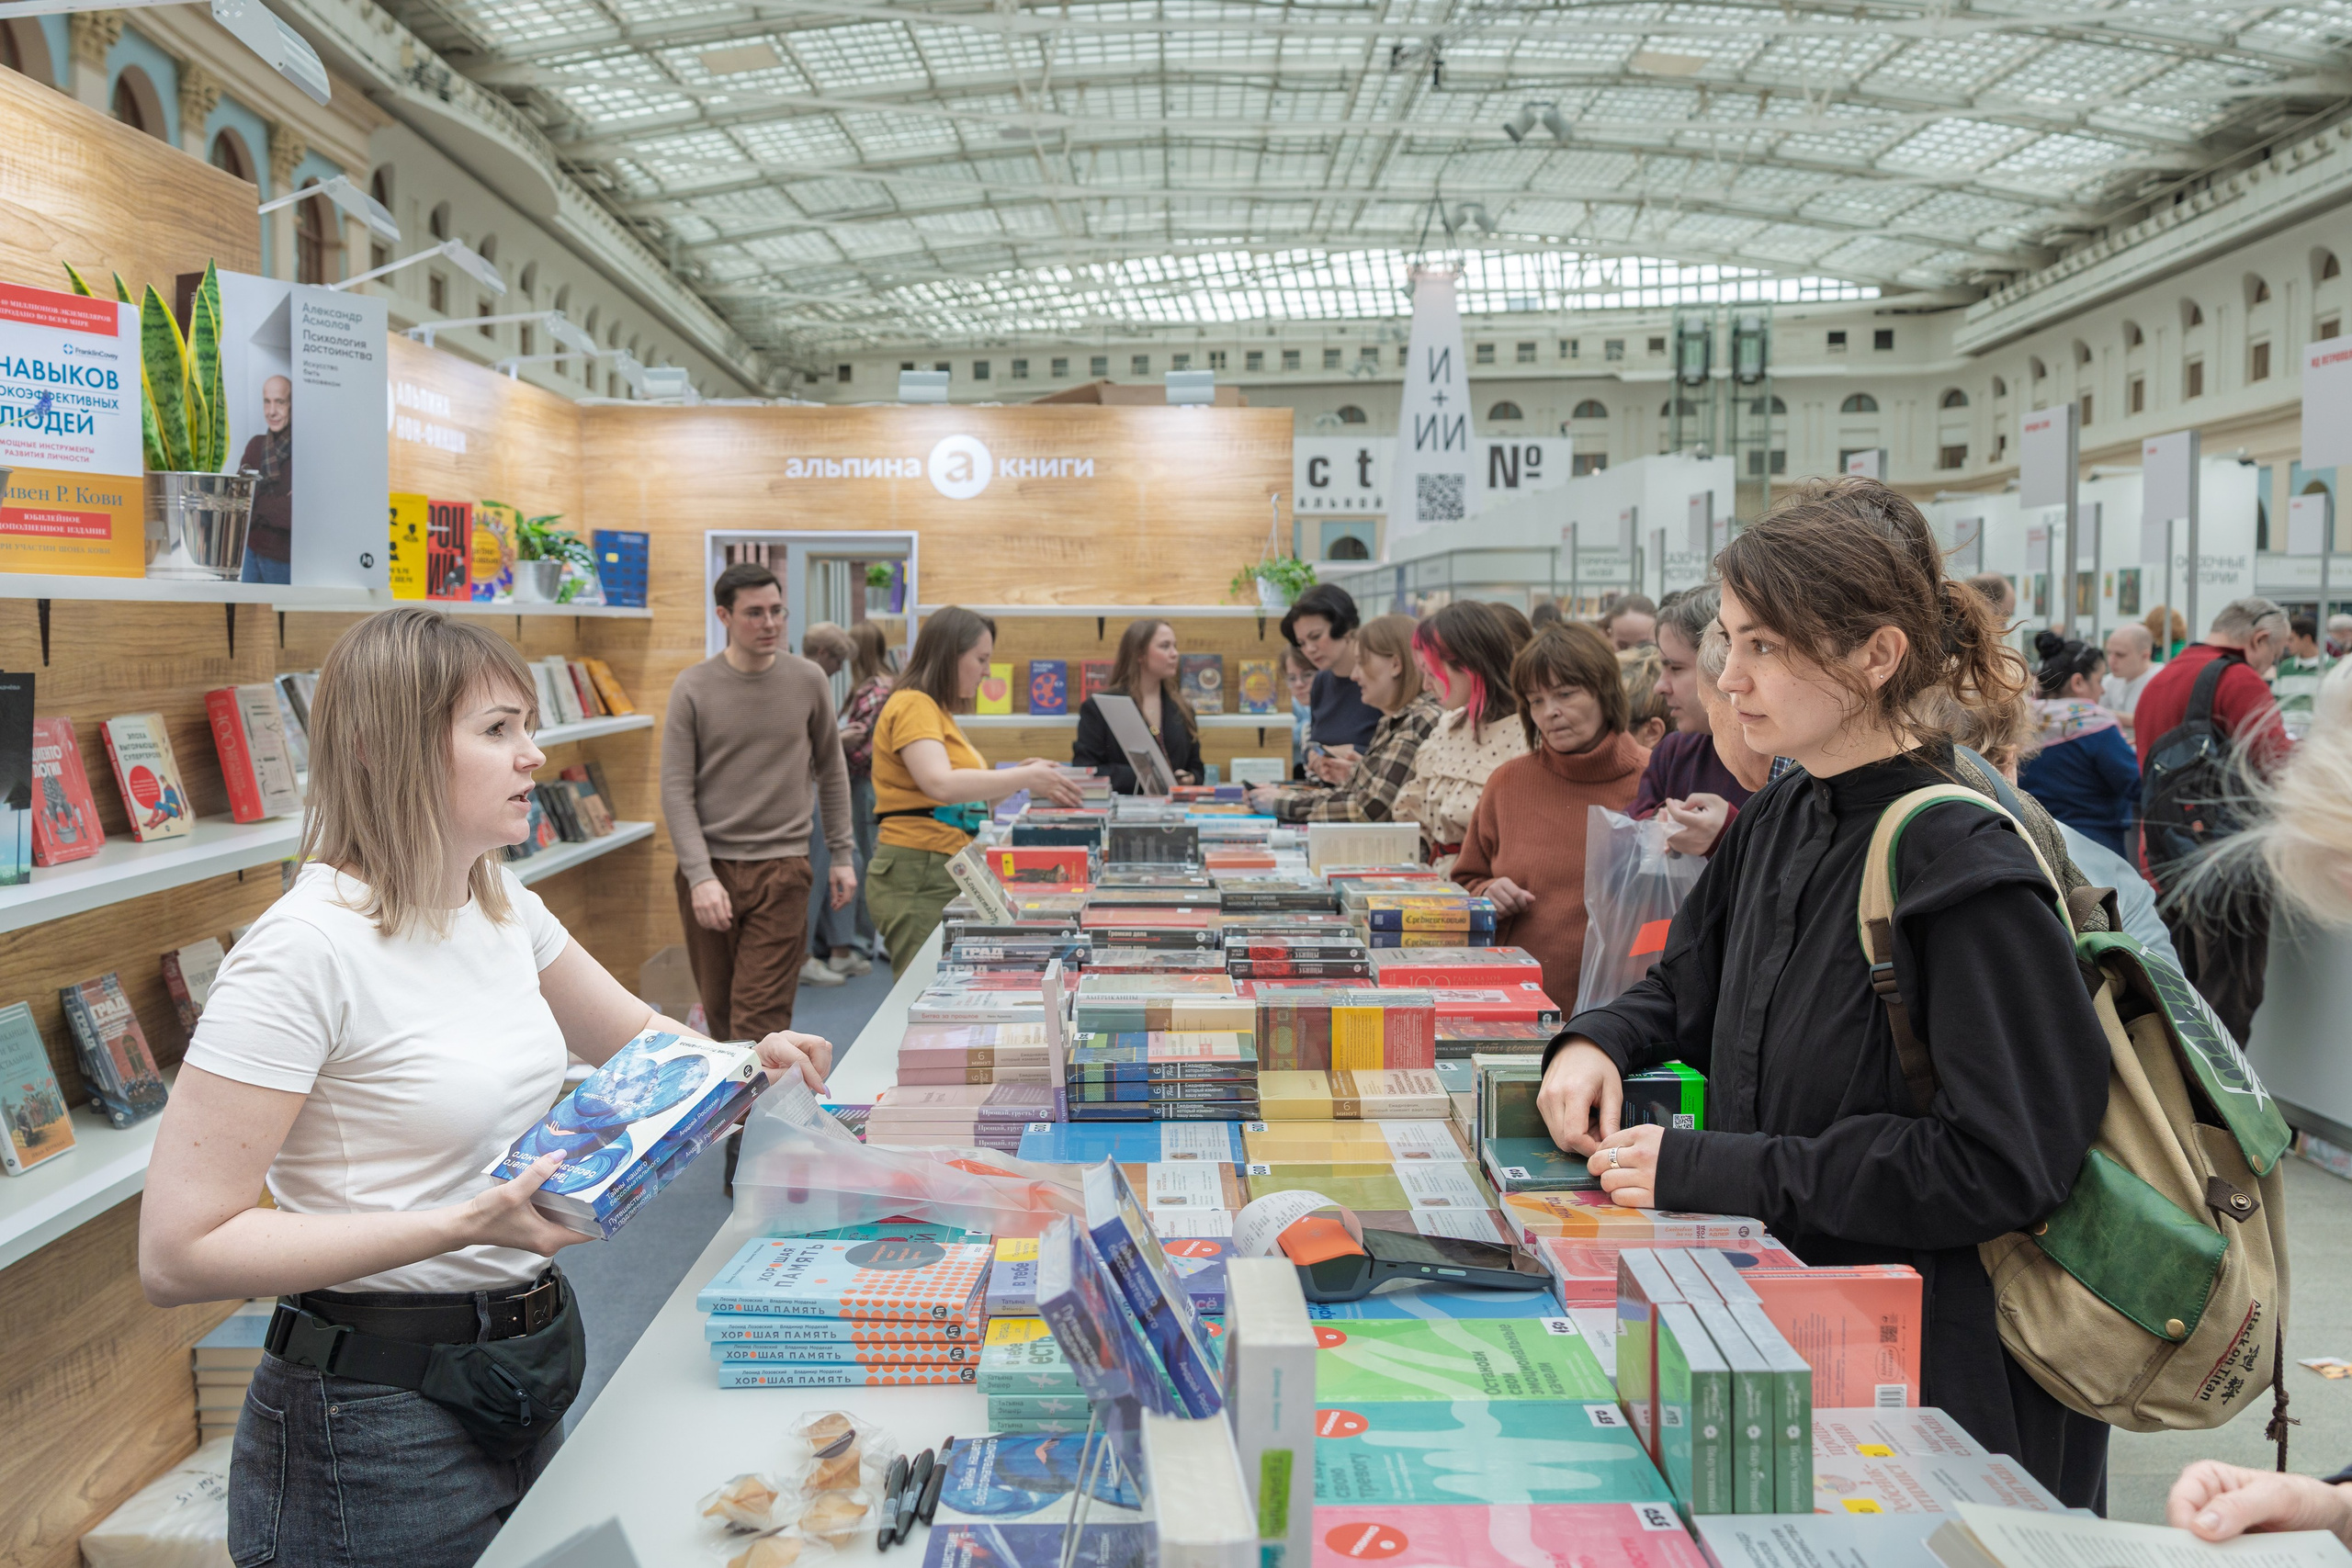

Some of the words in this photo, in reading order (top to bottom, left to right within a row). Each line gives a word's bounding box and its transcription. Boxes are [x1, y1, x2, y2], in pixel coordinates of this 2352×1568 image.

[10, 300, 58, 313] МИЛЛИОНОВ
[61, 309, 111, 321] ЭКЗЕМПЛЯРОВ
[302, 302, 362, 323] Александр
[48, 315, 67, 323] ВСЕМ
[70, 318, 88, 327] МИРЕ
[302, 313, 350, 331] Асмолов
[303, 329, 367, 349] Психология
[75, 347, 118, 360] FranklinCovey
[303, 344, 372, 361] достоинства
[0, 439, 36, 448] МОЩНЫЕ
[40, 443, 95, 454] ИНСТРУМЕНТЫ
[5, 449, 44, 458] РАЗВИТИЯ
[47, 454, 89, 462] ЛИЧНОСТИ
[786, 457, 922, 478] альпина
[1000, 457, 1094, 478] книги
[4, 486, 49, 502] ивен
[57, 485, 68, 502] Р.
[76, 487, 122, 505] Кови
[24, 513, 80, 524] ЮБИЛЕЙНОЕ
[67, 526, 107, 535] ИЗДАНИЕ
[978, 1051, 985, 1060] 6
[982, 1109, 1010, 1117] Прощай,
[1012, 1109, 1035, 1118] грусть!
[1343, 1101, 1351, 1111] 6
[679, 1116, 697, 1137] Андрей
[696, 1097, 720, 1120] Россохин
[703, 1118, 727, 1140] Россохин
[605, 1181, 626, 1201] Тайны
[626, 1160, 649, 1182] нашего
[609, 1157, 661, 1207] бессознательного
[607, 1189, 647, 1225] Путешествие
[617, 1192, 652, 1226] подлинному
[774, 1244, 825, 1287] ПАМЯТЬ
[774, 1306, 825, 1314] ПАМЯТЬ
[2237, 1298, 2262, 1348] Attack
[785, 1331, 837, 1339] ПАМЯТЬ
[1498, 1324, 1545, 1395] эмоциональные
[2223, 1348, 2242, 1366] on
[1538, 1362, 1566, 1395] качели
[2199, 1364, 2231, 1403] Titan
